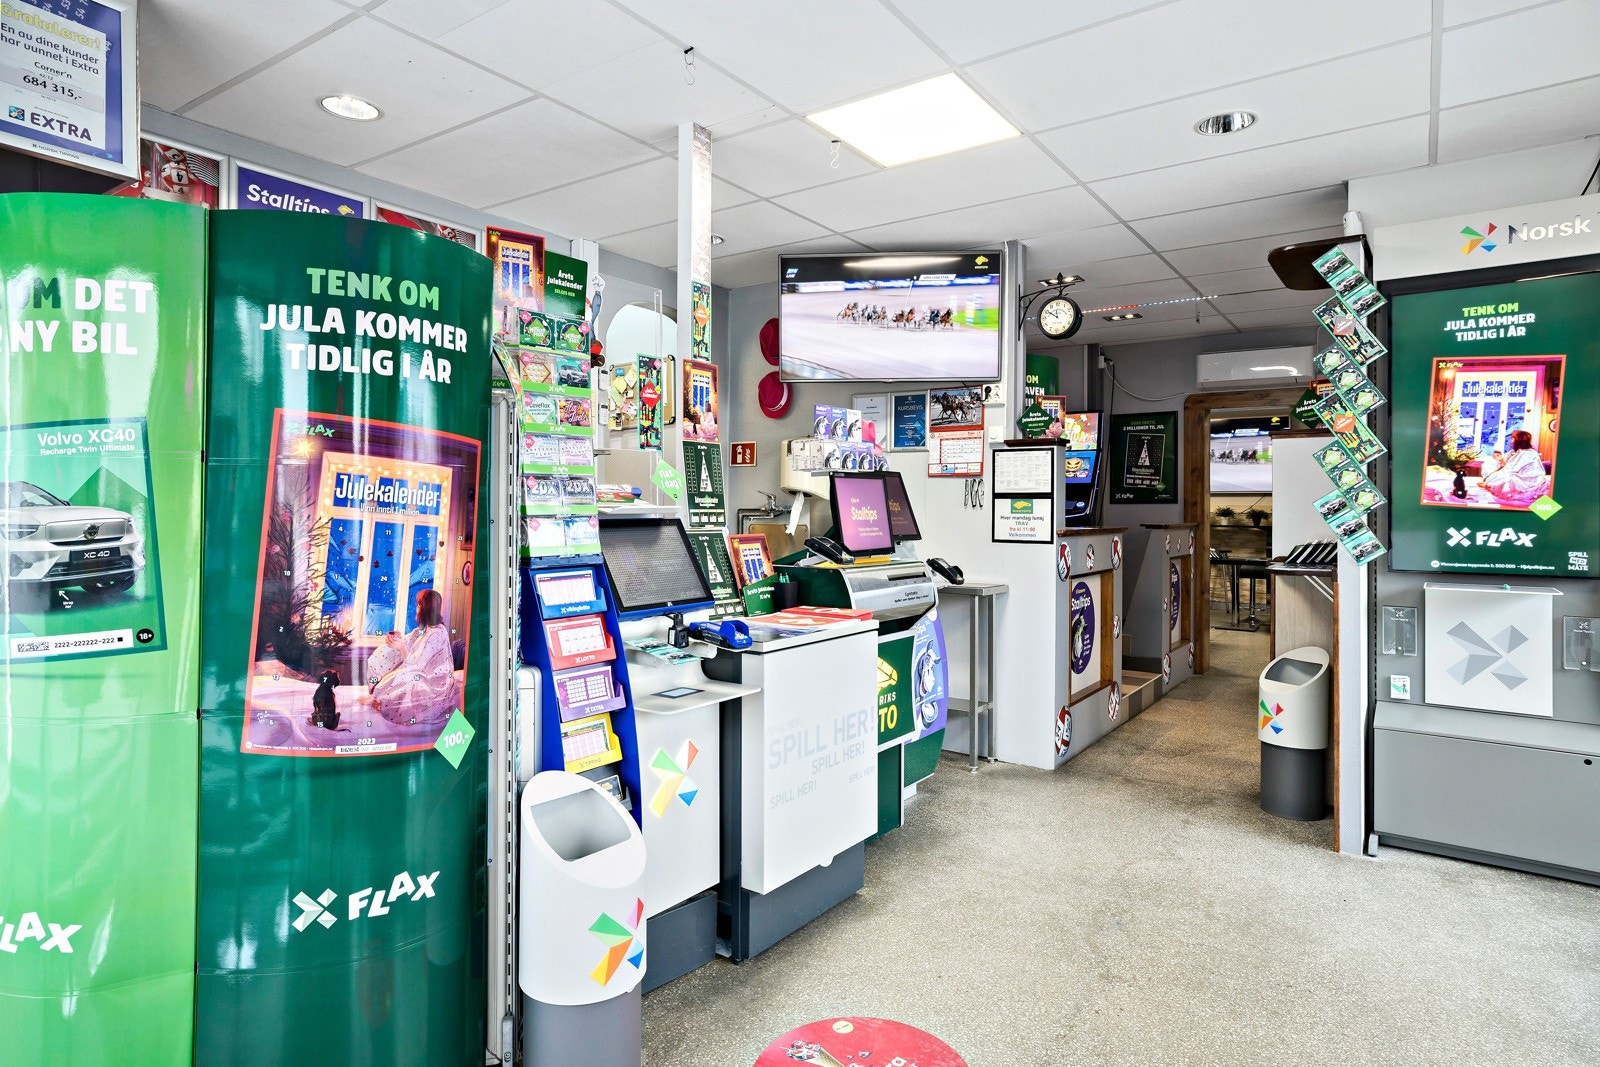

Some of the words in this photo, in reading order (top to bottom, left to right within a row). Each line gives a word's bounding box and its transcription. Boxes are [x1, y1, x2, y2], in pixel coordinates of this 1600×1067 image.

[0, 3, 101, 51] Gratulerer!
[0, 22, 15, 34] En
[18, 29, 33, 40] av
[35, 34, 60, 50] dine
[62, 45, 99, 64] kunder
[0, 34, 21, 46] har
[24, 43, 63, 62] vunnet
[65, 56, 69, 64] i
[72, 59, 99, 75] Extra
[23, 75, 47, 89] 684
[51, 82, 82, 100] 315,-
[30, 112, 92, 142] EXTRA
[1508, 215, 1592, 245] Norsk
[75, 277, 153, 313] DET
[307, 267, 393, 302] TENK
[399, 279, 440, 311] OM
[1443, 318, 1476, 331] JULA
[1479, 313, 1536, 328] KOMMER
[1462, 304, 1495, 317] TENK
[1498, 302, 1519, 314] OM
[11, 320, 60, 354] NY
[72, 320, 138, 355] BIL
[260, 303, 346, 335] JULA
[355, 309, 468, 353] KOMMER
[1455, 328, 1496, 342] TIDLIG
[1507, 324, 1526, 338] ÅR
[286, 343, 394, 377] TIDLIG
[403, 352, 411, 378] I
[419, 349, 452, 384] ÅR
[1464, 380, 1526, 396] Julekalender
[37, 432, 83, 446] Volvo
[88, 428, 136, 443] XC40
[40, 446, 77, 456] Recharge
[78, 445, 97, 453] Twin
[335, 474, 440, 508] Julekalender
[1476, 527, 1537, 547] FLAX
[1568, 563, 1588, 571] MÅTE
[139, 632, 153, 640] 18+
[879, 692, 896, 705] RIKS
[878, 705, 897, 732] TO
[443, 731, 470, 748] 100,-
[769, 724, 827, 769] SPILL
[833, 706, 875, 747] HER!
[812, 753, 840, 775] SPILL
[843, 741, 865, 759] HER!
[770, 791, 796, 809] SPILL
[798, 779, 817, 796] HER!
[348, 870, 440, 921] FLAX
